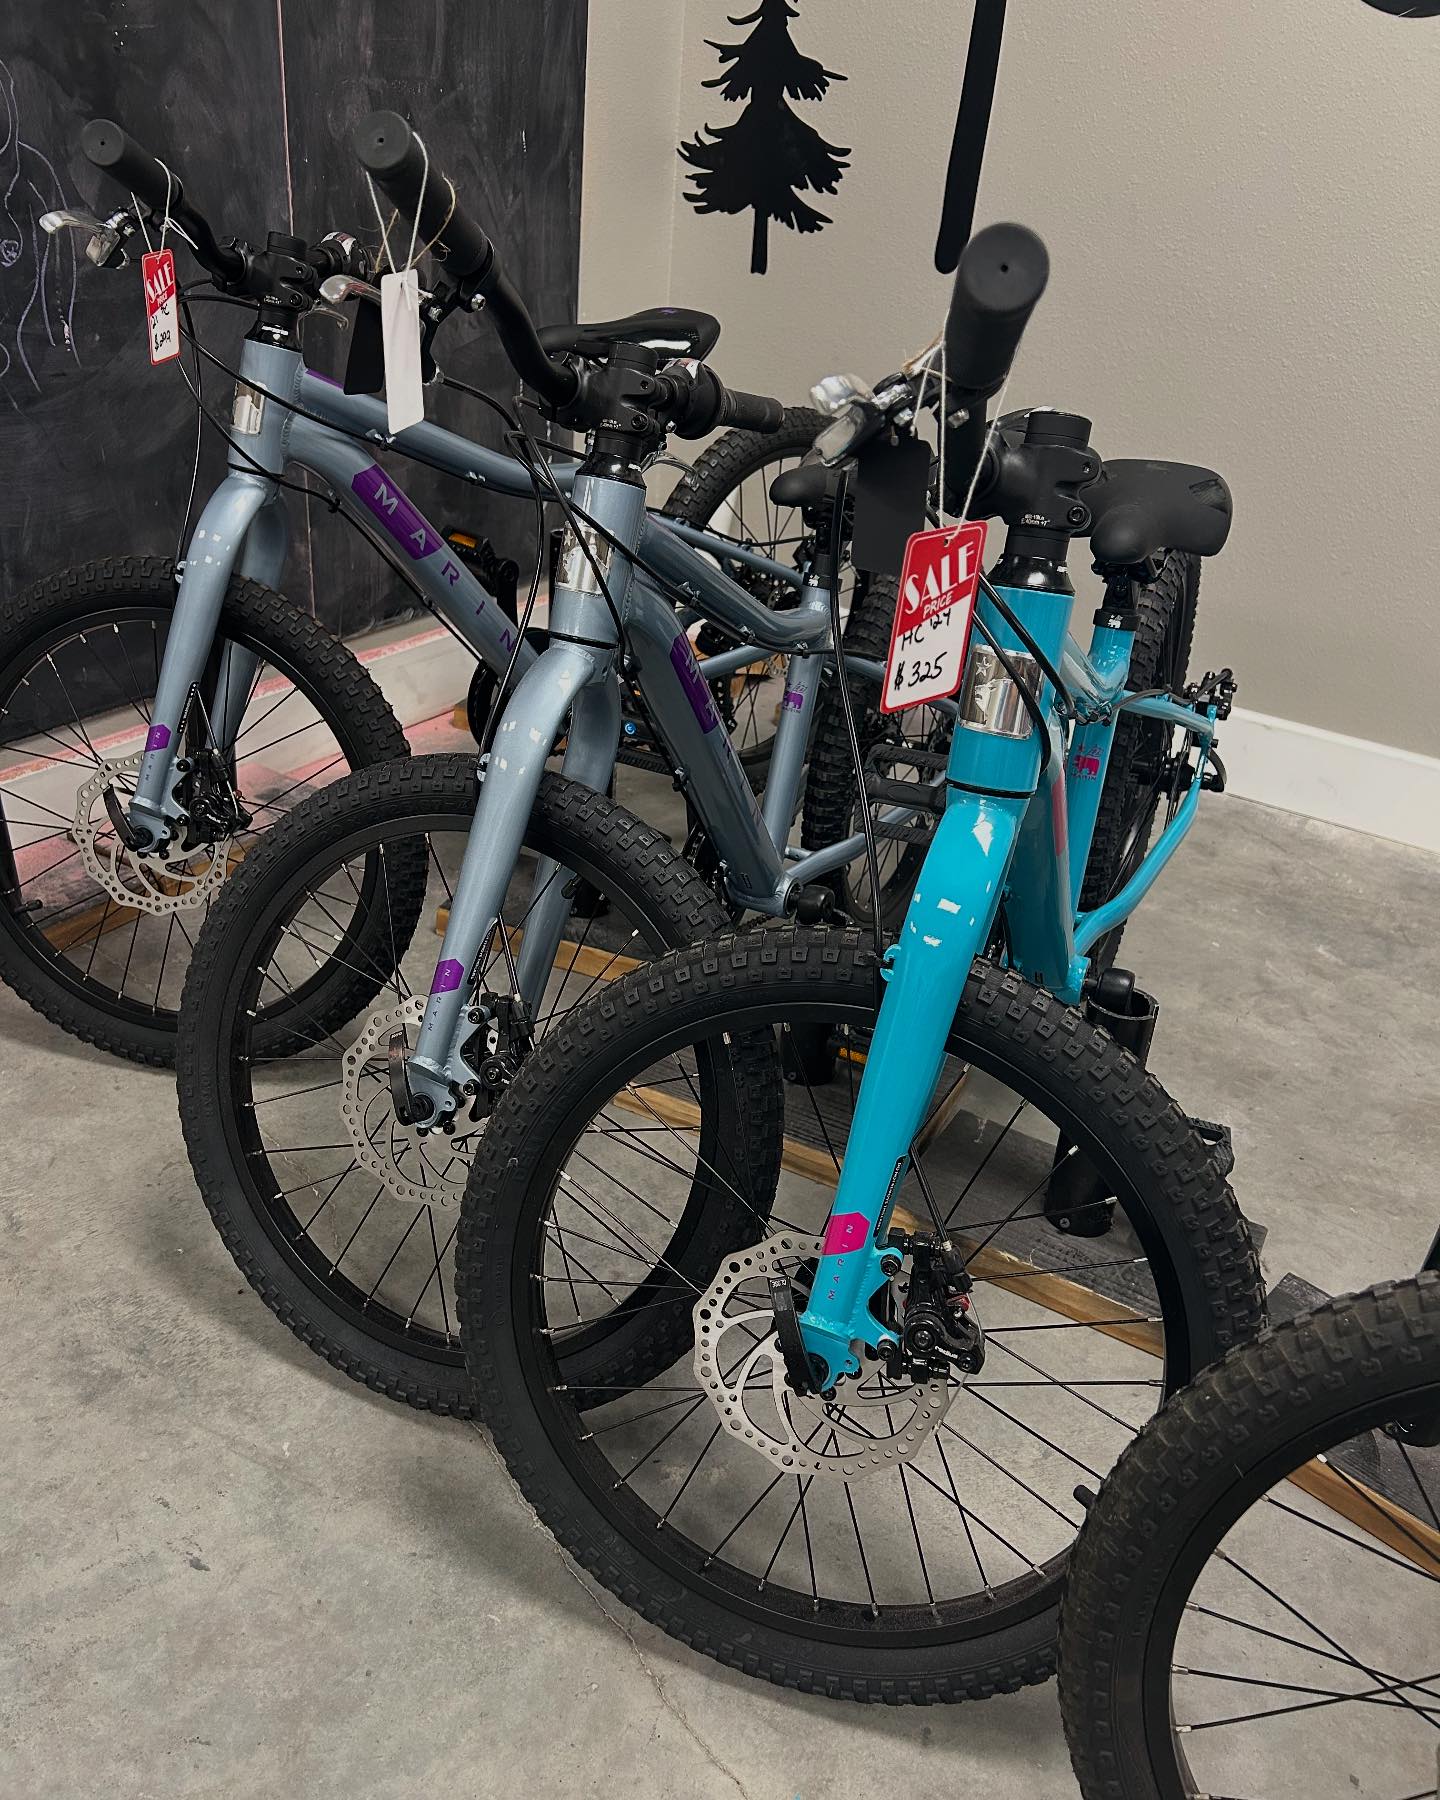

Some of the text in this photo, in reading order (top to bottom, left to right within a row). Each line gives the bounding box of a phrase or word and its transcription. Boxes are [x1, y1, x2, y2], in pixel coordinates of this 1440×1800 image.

[147, 261, 174, 303] SALE
[374, 483, 517, 653] MARIN
[904, 541, 976, 614] SALE
[922, 590, 953, 619] PRICE
[901, 624, 925, 651] HC
[428, 968, 451, 1032] MARIN
[828, 1224, 854, 1300] MARIN
